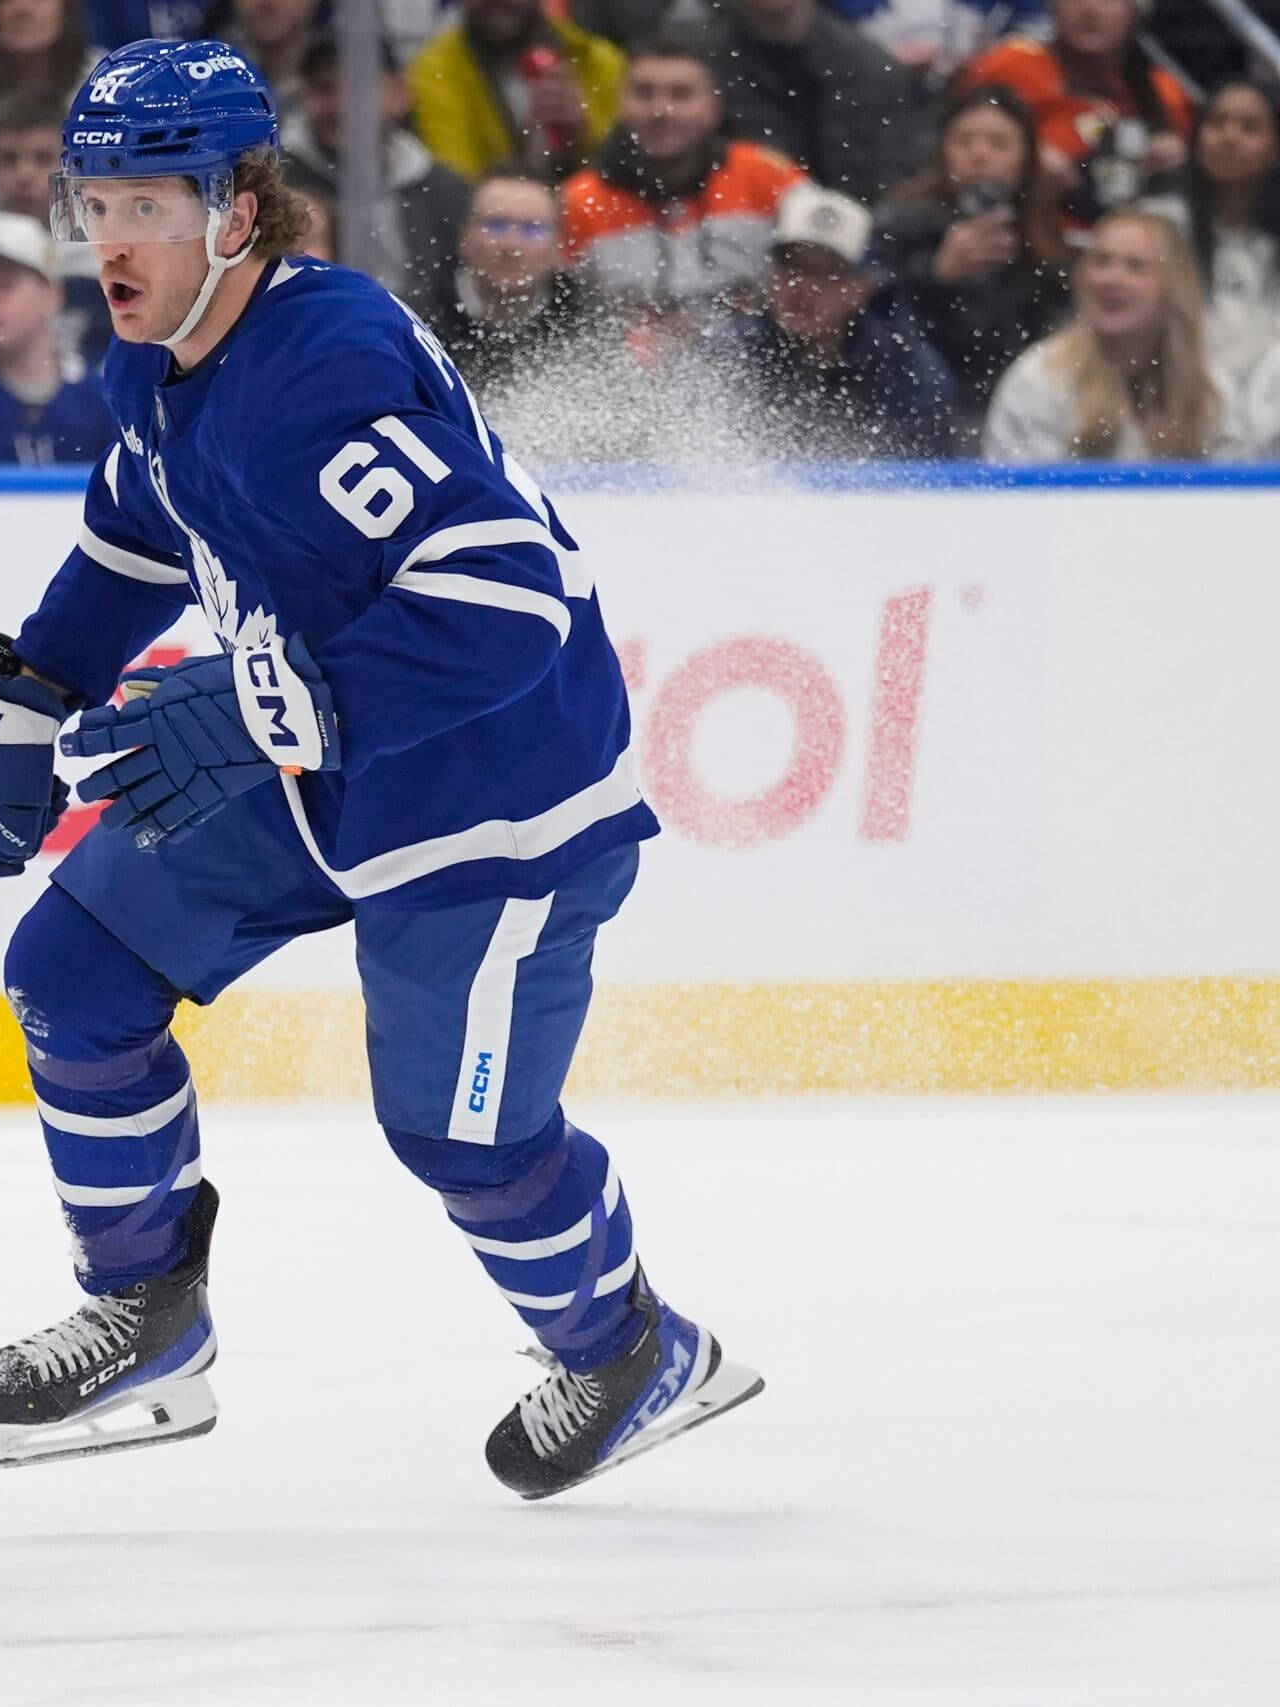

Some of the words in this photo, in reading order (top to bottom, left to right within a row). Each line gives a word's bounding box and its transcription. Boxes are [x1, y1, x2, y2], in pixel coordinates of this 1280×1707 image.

[73, 131, 122, 144] CCM
[319, 415, 452, 539] 61
[246, 643, 299, 746] CM
[469, 1052, 492, 1113] CCM
[79, 1352, 137, 1396] CCM
